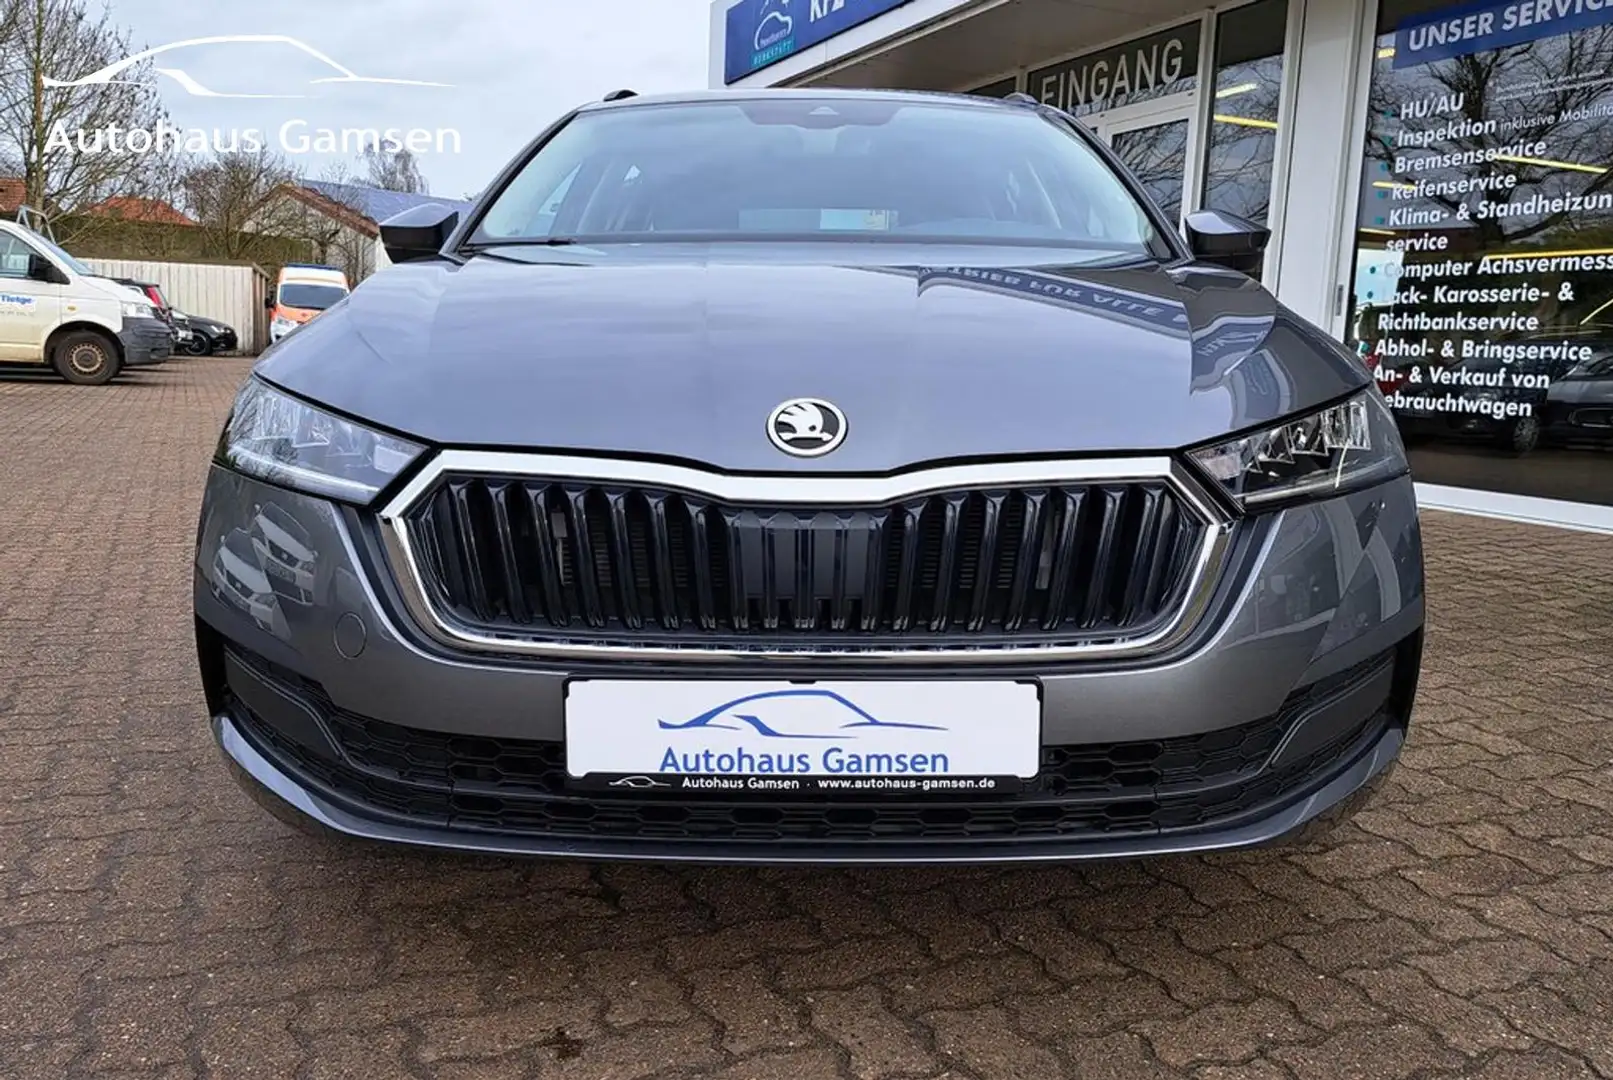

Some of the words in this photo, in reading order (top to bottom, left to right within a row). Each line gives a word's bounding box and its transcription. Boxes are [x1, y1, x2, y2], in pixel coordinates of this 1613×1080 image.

[1409, 12, 1495, 51] UNSER
[1041, 39, 1184, 109] EINGANG
[1401, 93, 1465, 121] HU/AU
[1396, 118, 1497, 149] Inspektion
[1500, 114, 1556, 132] inklusive
[1395, 140, 1547, 174] Bremsenservice
[1391, 172, 1517, 201] Reifenservice
[1388, 207, 1450, 227] Klima-
[1456, 203, 1471, 221] &
[1477, 191, 1613, 220] Standheizun
[1385, 232, 1449, 252] service
[1434, 281, 1550, 304] Karosserie-
[1557, 282, 1574, 301] &
[1377, 310, 1539, 331] Richtbankservice
[1374, 338, 1435, 357] Abhol-
[1440, 340, 1455, 358] &
[1461, 339, 1593, 363] Bringservice
[1373, 364, 1403, 382] An-
[1408, 366, 1423, 384] &
[1429, 366, 1505, 387] Verkauf
[1511, 372, 1550, 390] von
[1384, 390, 1532, 421] ebrauchtwagen
[659, 747, 811, 774] Autohaus
[823, 747, 949, 773] Gamsen
[682, 777, 744, 790] Autohaus
[748, 777, 800, 790] Gamsen
[818, 778, 996, 791] www.autohaus-gamsen.de
